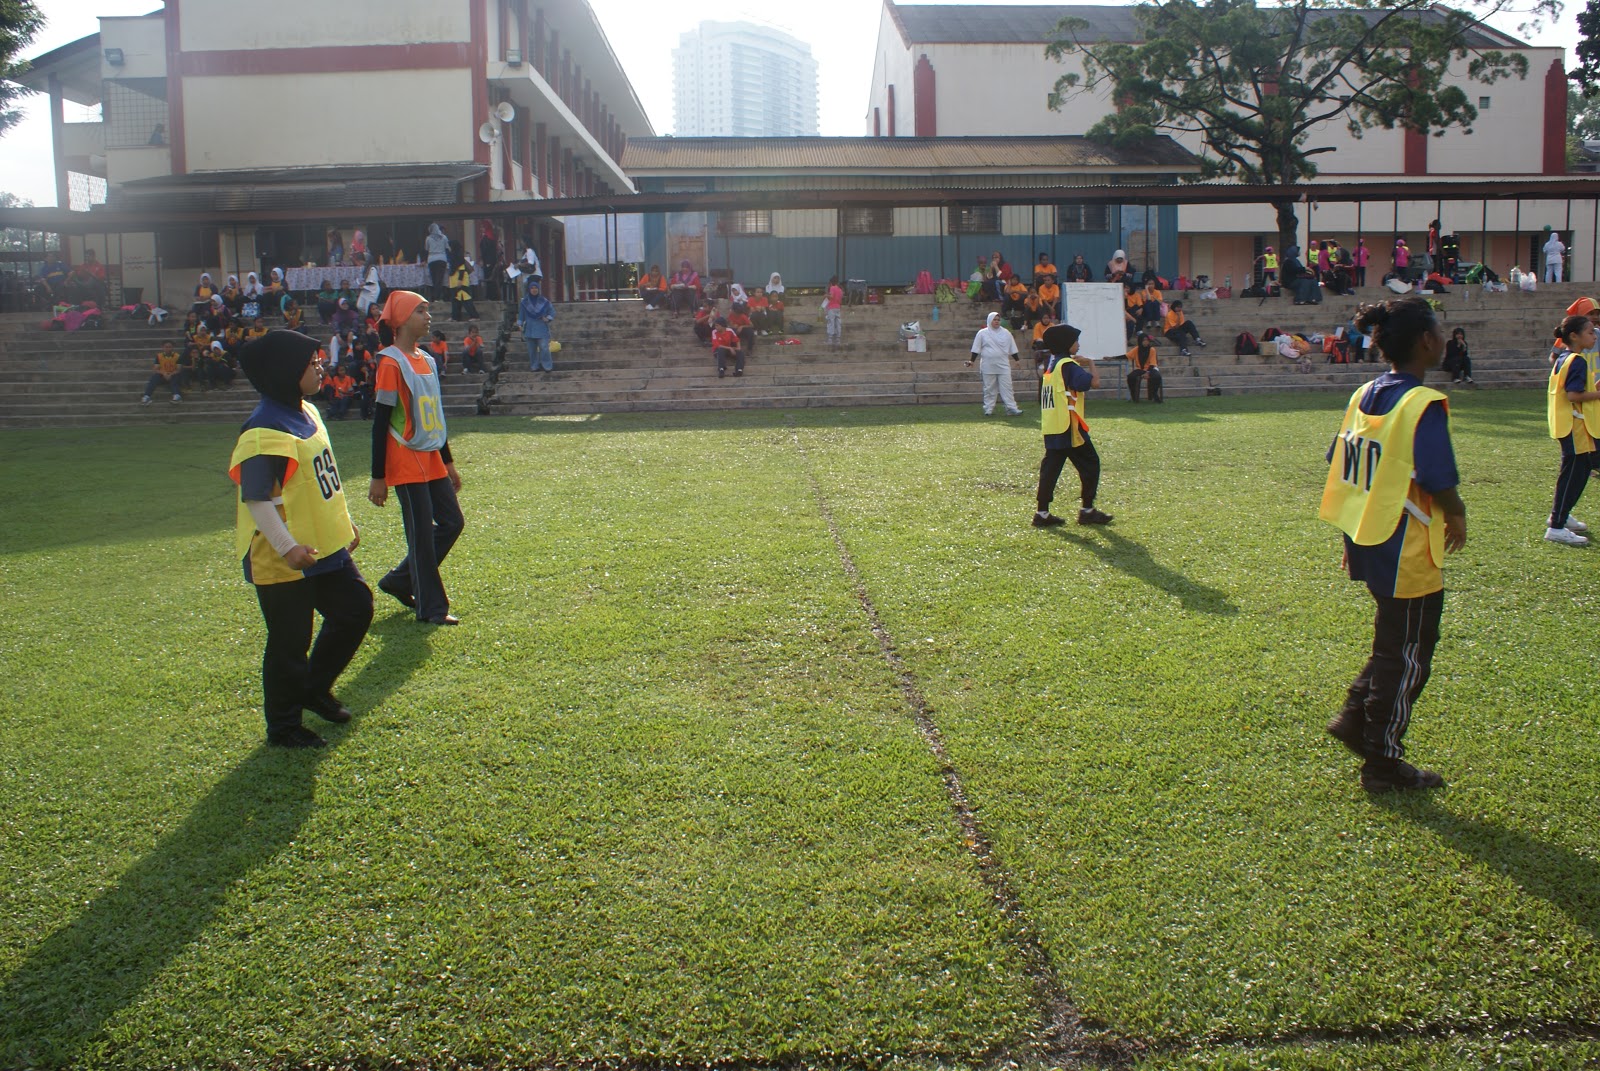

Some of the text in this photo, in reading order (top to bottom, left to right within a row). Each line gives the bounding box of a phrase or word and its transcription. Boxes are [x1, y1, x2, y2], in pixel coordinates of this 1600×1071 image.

[1042, 385, 1055, 409] WA
[313, 448, 341, 500] GS
[1342, 430, 1382, 492] WD
